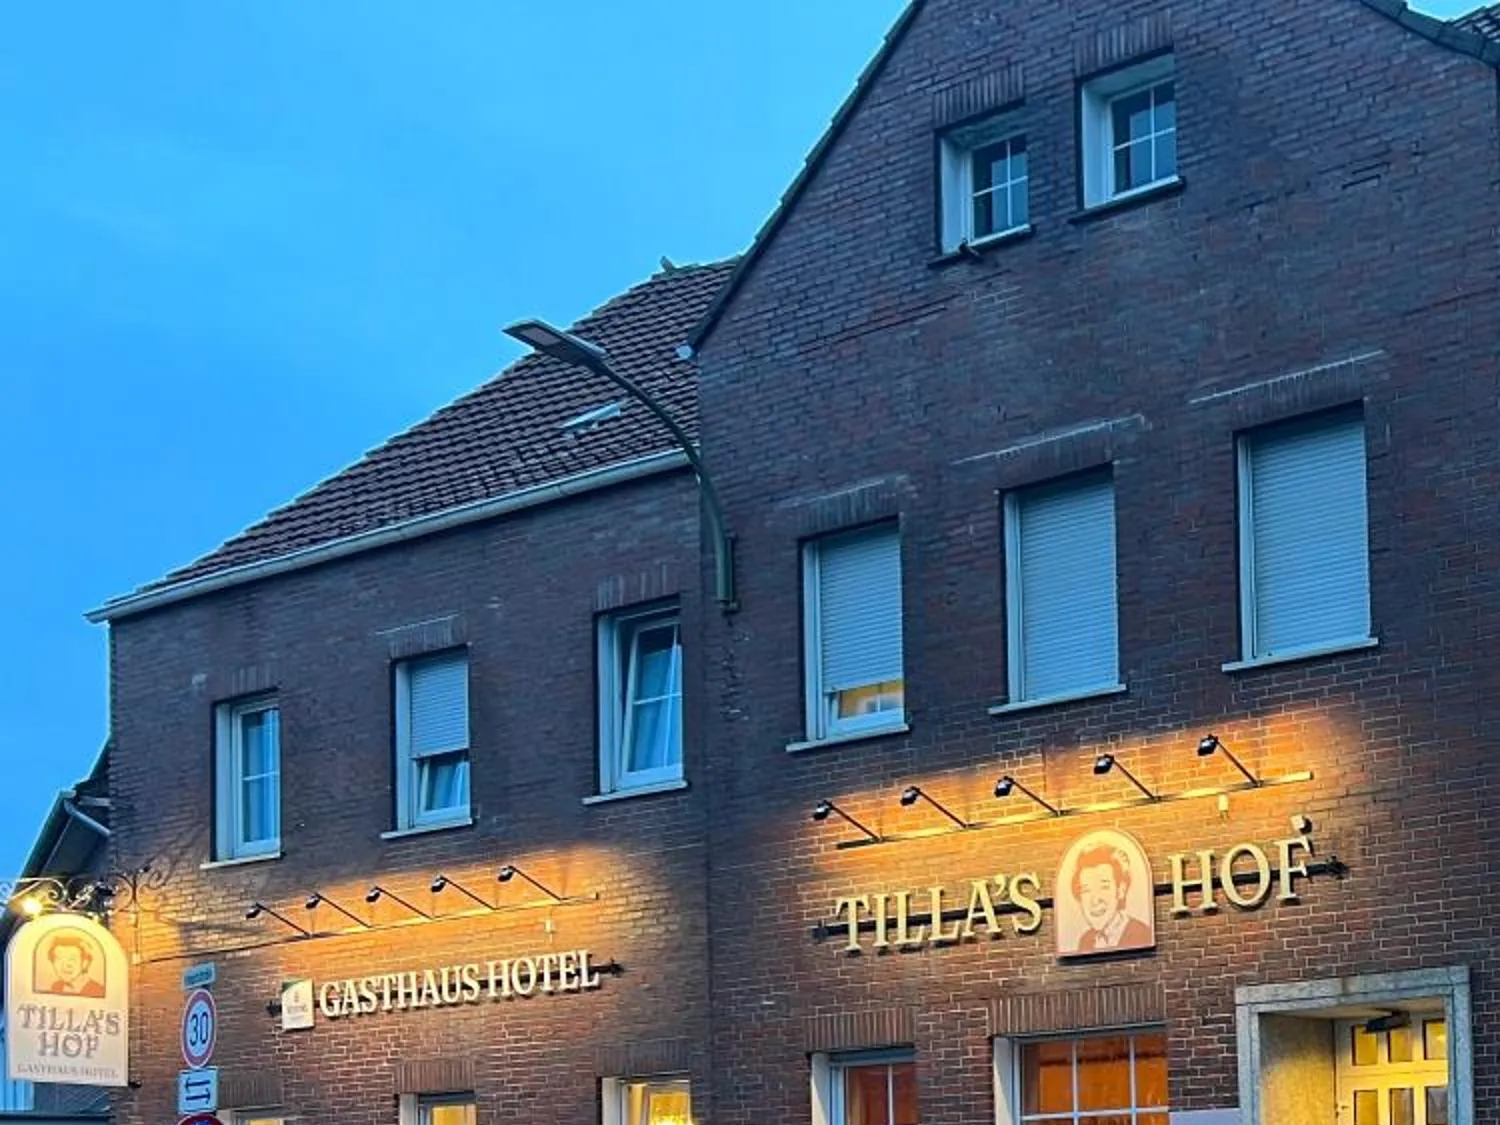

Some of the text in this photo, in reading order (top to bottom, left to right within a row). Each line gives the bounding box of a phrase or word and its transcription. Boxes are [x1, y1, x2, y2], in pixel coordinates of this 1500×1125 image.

[835, 834, 1313, 951] TILLA'S HOF
[318, 949, 601, 1018] GASTHAUS HOTEL
[16, 1003, 120, 1036] TILLA'S
[189, 1011, 209, 1047] 30
[38, 1030, 99, 1059] HOF
